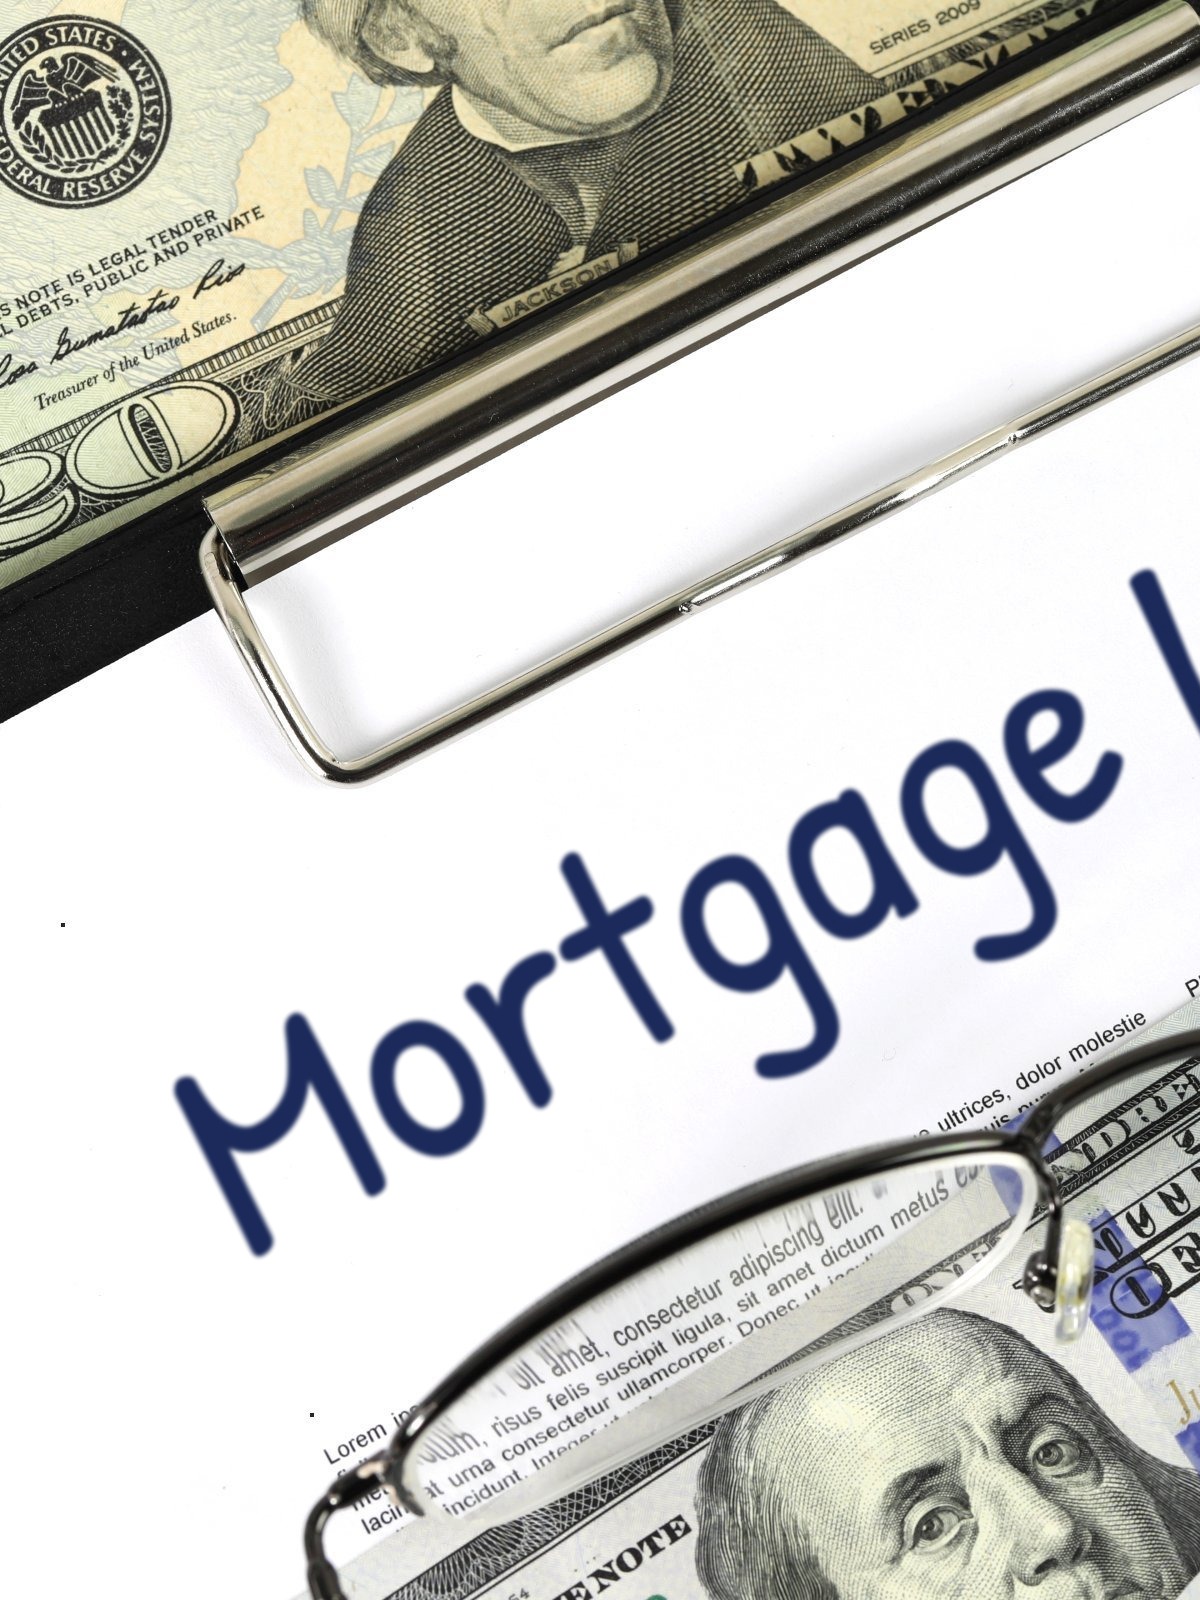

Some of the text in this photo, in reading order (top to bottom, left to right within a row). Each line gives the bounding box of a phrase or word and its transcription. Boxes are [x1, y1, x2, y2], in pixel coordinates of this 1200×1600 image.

[45, 26, 117, 53] STATES
[869, 0, 981, 55] SERIES 2009
[128, 58, 161, 144] SYSTEM
[62, 148, 147, 199] RESERVE
[14, 209, 218, 310] NOTE IS LEGAL TENDER
[83, 259, 149, 298] PUBLIC
[153, 241, 190, 268] AND
[195, 205, 266, 248] PRIVATE
[502, 259, 613, 322] JACKSON
[33, 373, 100, 411] Treasurer
[102, 361, 117, 382] of
[119, 355, 140, 373] the
[141, 328, 191, 361] United
[189, 313, 238, 340] States.
[323, 1423, 388, 1465] Lorem
[612, 1278, 724, 1347] consectetur
[728, 1216, 825, 1288] adipiscing
[936, 1088, 1012, 1133] ultrices,
[1015, 1055, 1063, 1091] dolor
[1068, 1012, 1148, 1063] molestie
[490, 1404, 543, 1438] risus
[546, 1382, 590, 1412] felis
[595, 1340, 669, 1388] suscipit
[671, 1312, 733, 1347] ligula,
[736, 1290, 762, 1313] sit
[766, 1259, 817, 1297] amet
[820, 1223, 886, 1268] dictum
[889, 1177, 950, 1230] metus
[447, 1457, 497, 1489] urna
[501, 1396, 611, 1463] consectetur
[735, 1298, 801, 1339] Donec
[586, 1513, 693, 1595] NOTE
